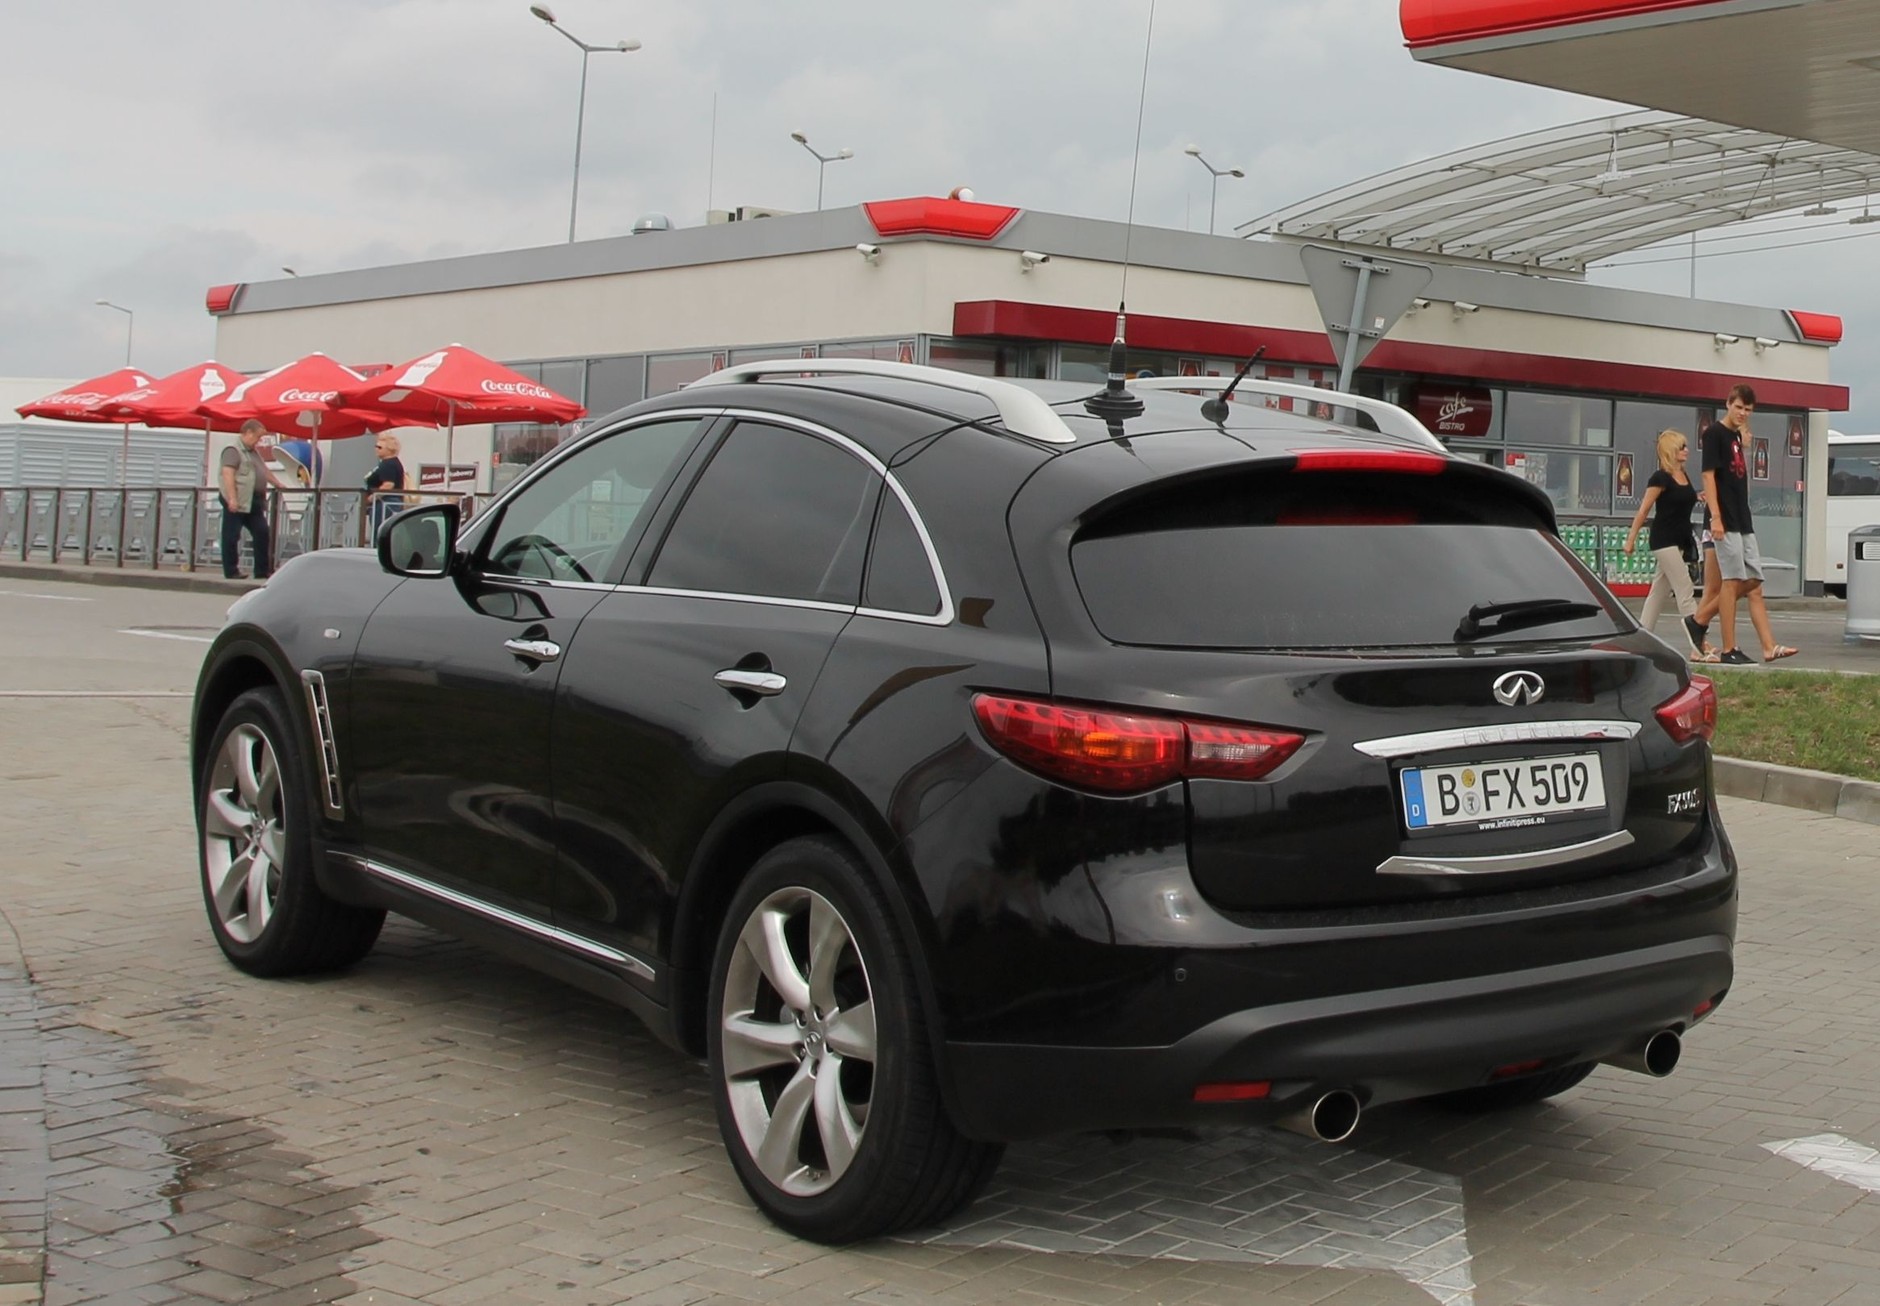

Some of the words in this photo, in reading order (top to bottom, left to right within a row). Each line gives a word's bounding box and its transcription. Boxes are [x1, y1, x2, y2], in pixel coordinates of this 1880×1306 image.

[481, 379, 552, 398] Coca-Cola
[1439, 421, 1465, 431] BISTRO
[1437, 774, 1460, 816] B
[1481, 768, 1526, 811] FX
[1530, 762, 1589, 806] 509
[1411, 804, 1420, 817] D
